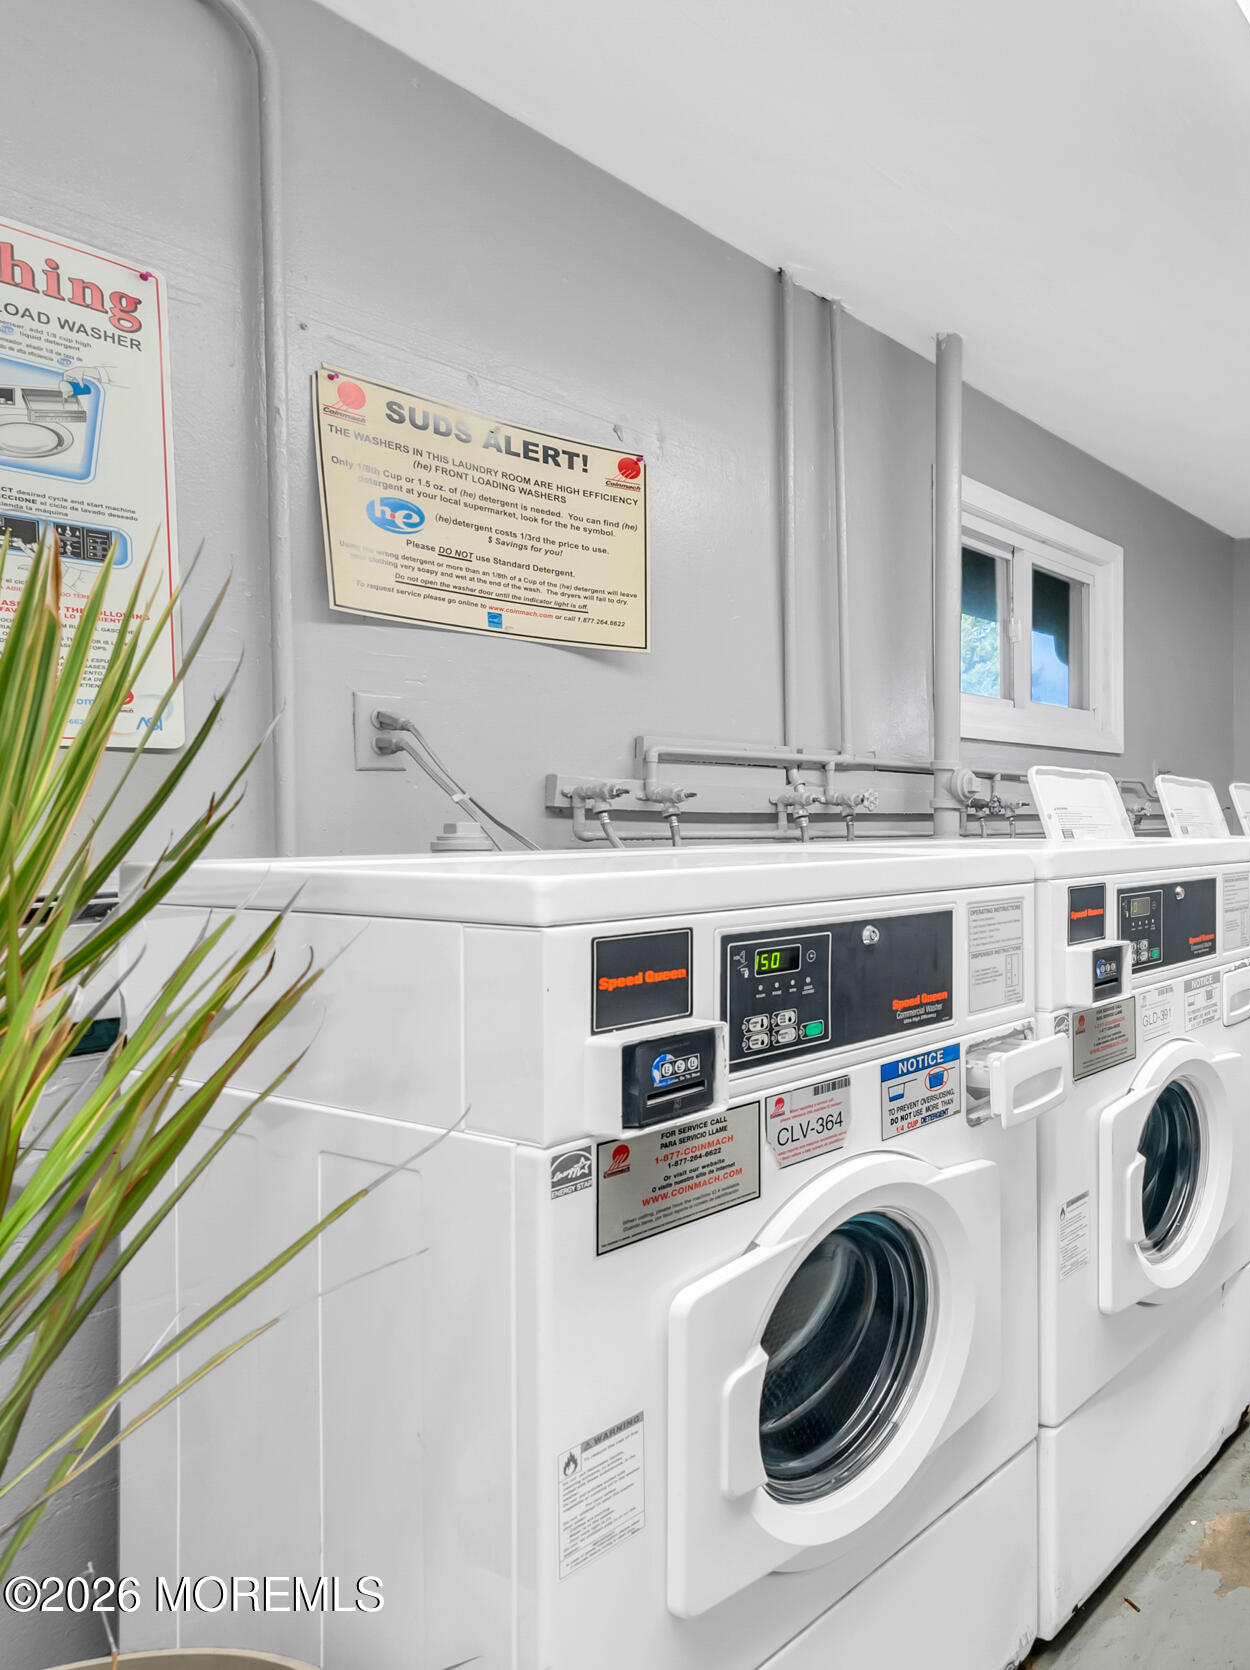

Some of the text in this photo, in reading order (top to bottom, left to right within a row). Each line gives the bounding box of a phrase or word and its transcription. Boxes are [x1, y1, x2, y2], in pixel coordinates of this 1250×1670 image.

[0, 302, 50, 324] OAD
[56, 316, 143, 352] WASHER
[385, 401, 589, 473] SUDS ALERT!
[328, 424, 638, 506] THE WASHERS IN THIS LAUNDRY ROOM ARE HIGH EFFICIENCY
[331, 456, 355, 470] Only
[383, 470, 402, 482] Cup
[417, 478, 431, 488] 1.5
[433, 484, 446, 492] oz.
[449, 487, 457, 495] of
[459, 489, 476, 500] (he)
[478, 494, 519, 510] detergent
[531, 507, 563, 518] needed.
[568, 513, 584, 522] You
[603, 519, 619, 528] find
[622, 523, 638, 532] (he)
[413, 460, 567, 504] (he) FRONT LOADING WASHERS
[605, 480, 641, 491] Coinmach
[16, 490, 46, 499] desired
[48, 495, 68, 503] cycle
[105, 505, 136, 514] machine
[81, 508, 106, 516] lavado
[108, 511, 138, 521] deseado
[417, 490, 437, 502] your
[440, 494, 461, 506] local
[464, 501, 518, 520] supermarket,
[520, 513, 539, 524] look
[541, 517, 553, 526] for
[554, 521, 568, 529] the
[583, 527, 616, 537] symbol.
[495, 529, 517, 538] costs
[520, 533, 541, 543] 1/3rd
[543, 537, 556, 546] the
[558, 541, 579, 551] price
[592, 547, 610, 555] use.
[495, 537, 528, 551] Savings
[530, 545, 542, 553] for
[544, 548, 563, 557] you!
[406, 539, 576, 578] Please DO NOT use Standard Detergent.
[400, 563, 416, 572] very
[417, 566, 438, 577] soapy
[455, 573, 467, 581] wet
[523, 585, 542, 593] wash.
[546, 588, 558, 596] The
[560, 591, 581, 600] dryers
[583, 593, 595, 601] will
[401, 555, 435, 567] detergent
[446, 564, 463, 572] more
[465, 566, 480, 574] than
[524, 578, 537, 586] Cup
[574, 586, 606, 595] detergent
[620, 591, 638, 599] leave
[367, 583, 395, 593] request
[396, 588, 422, 598] service
[423, 593, 446, 603] please
[458, 599, 478, 608] online
[488, 605, 553, 619] www.coinmach.com
[420, 578, 438, 589] open
[452, 584, 476, 593] washer
[478, 588, 494, 596] door
[495, 591, 510, 599] until
[511, 593, 522, 601] the
[523, 596, 553, 605] indicator
[554, 600, 569, 608] light
[598, 968, 687, 991] Speed Queen
[892, 991, 948, 1011] Speed Queen
[896, 1003, 943, 1019] Commercial Washer
[898, 1050, 944, 1074] NOTICE
[888, 1108, 895, 1116] TO
[897, 1100, 919, 1113] PREVENT
[900, 1113, 912, 1121] NOT
[913, 1109, 923, 1117] USE
[925, 1103, 939, 1113] MORE
[941, 1098, 954, 1107] THAN
[660, 1116, 727, 1140] FOR SERVICE CALL
[777, 1111, 843, 1146] CLV-364
[907, 1120, 918, 1129] CUP
[654, 1135, 734, 1164] 1-877-COINMACH
[660, 1125, 728, 1150] PARA SERVICIO LLAME
[668, 1147, 722, 1169] 1-877-264-6622
[674, 1170, 687, 1179] visit
[702, 1159, 726, 1171] website
[674, 1175, 694, 1187] nuestro
[715, 1162, 736, 1173] internet
[642, 1168, 743, 1207] WWW.COINMACH.COM
[594, 1415, 640, 1445] WARNING
